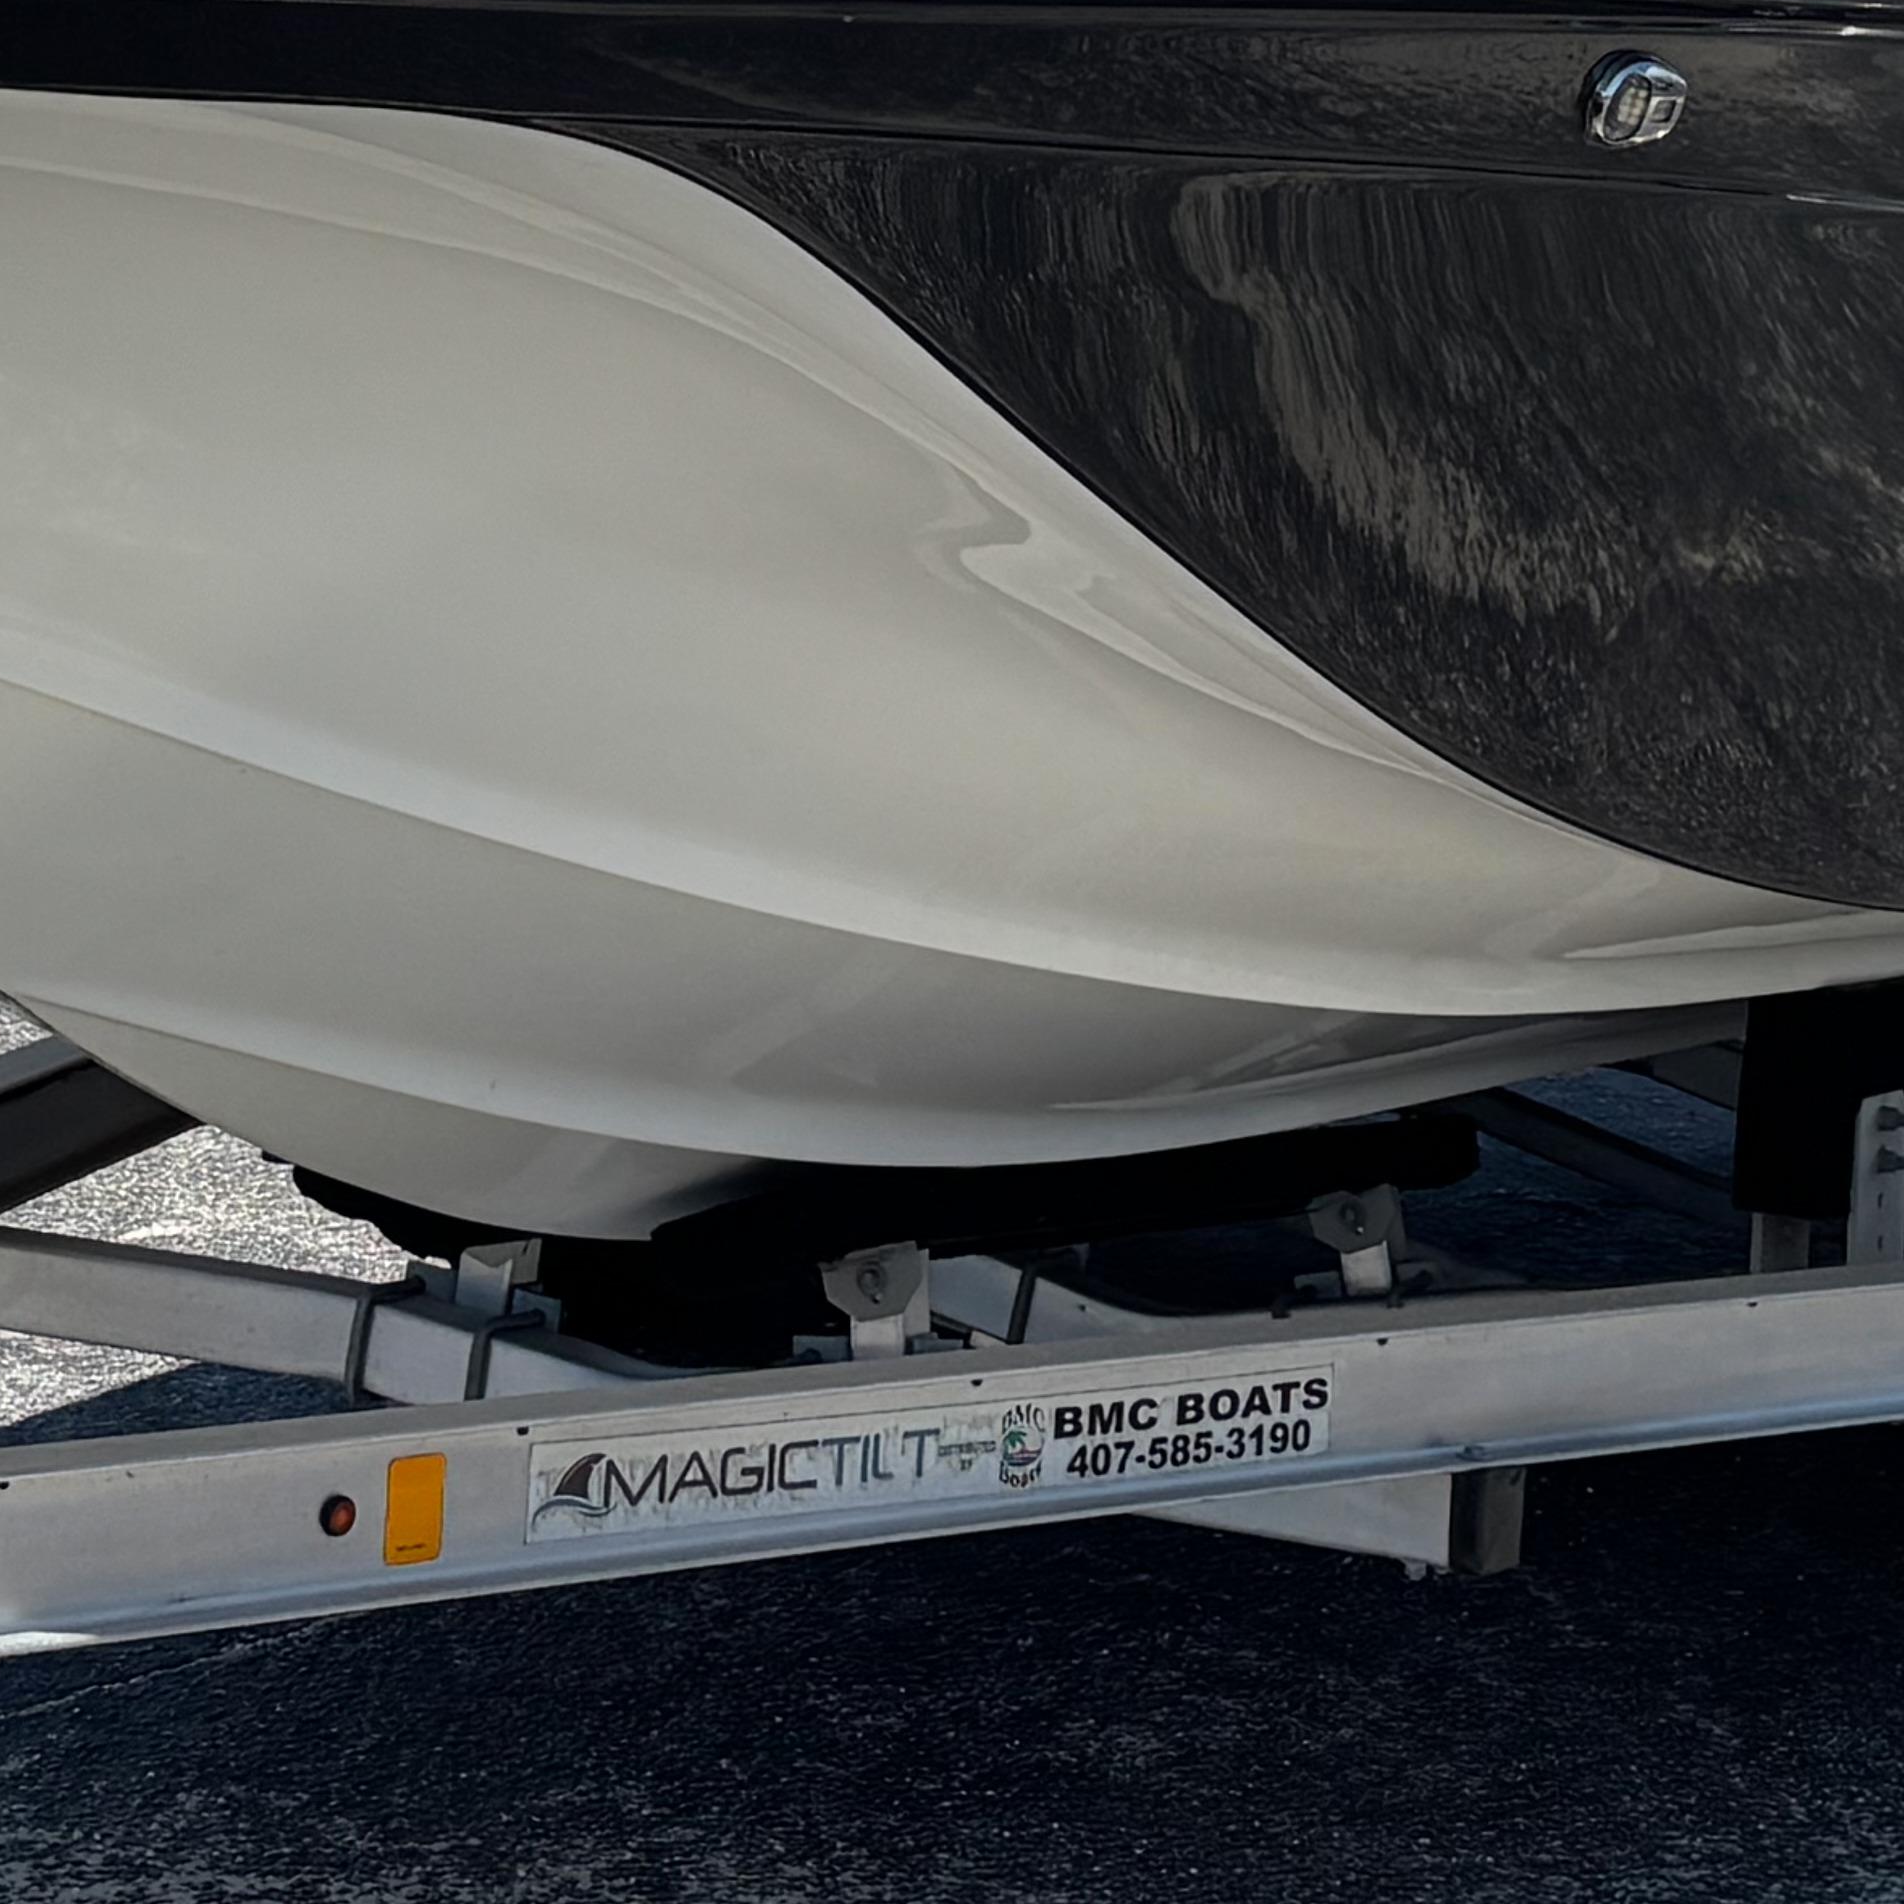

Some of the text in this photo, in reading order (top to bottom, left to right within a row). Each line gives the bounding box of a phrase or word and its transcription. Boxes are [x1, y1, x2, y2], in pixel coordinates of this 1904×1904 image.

[1053, 1377, 1330, 1440] BMC BOATS
[603, 1428, 940, 1507] MAGICTILT
[1066, 1418, 1312, 1479] 407-585-3190
